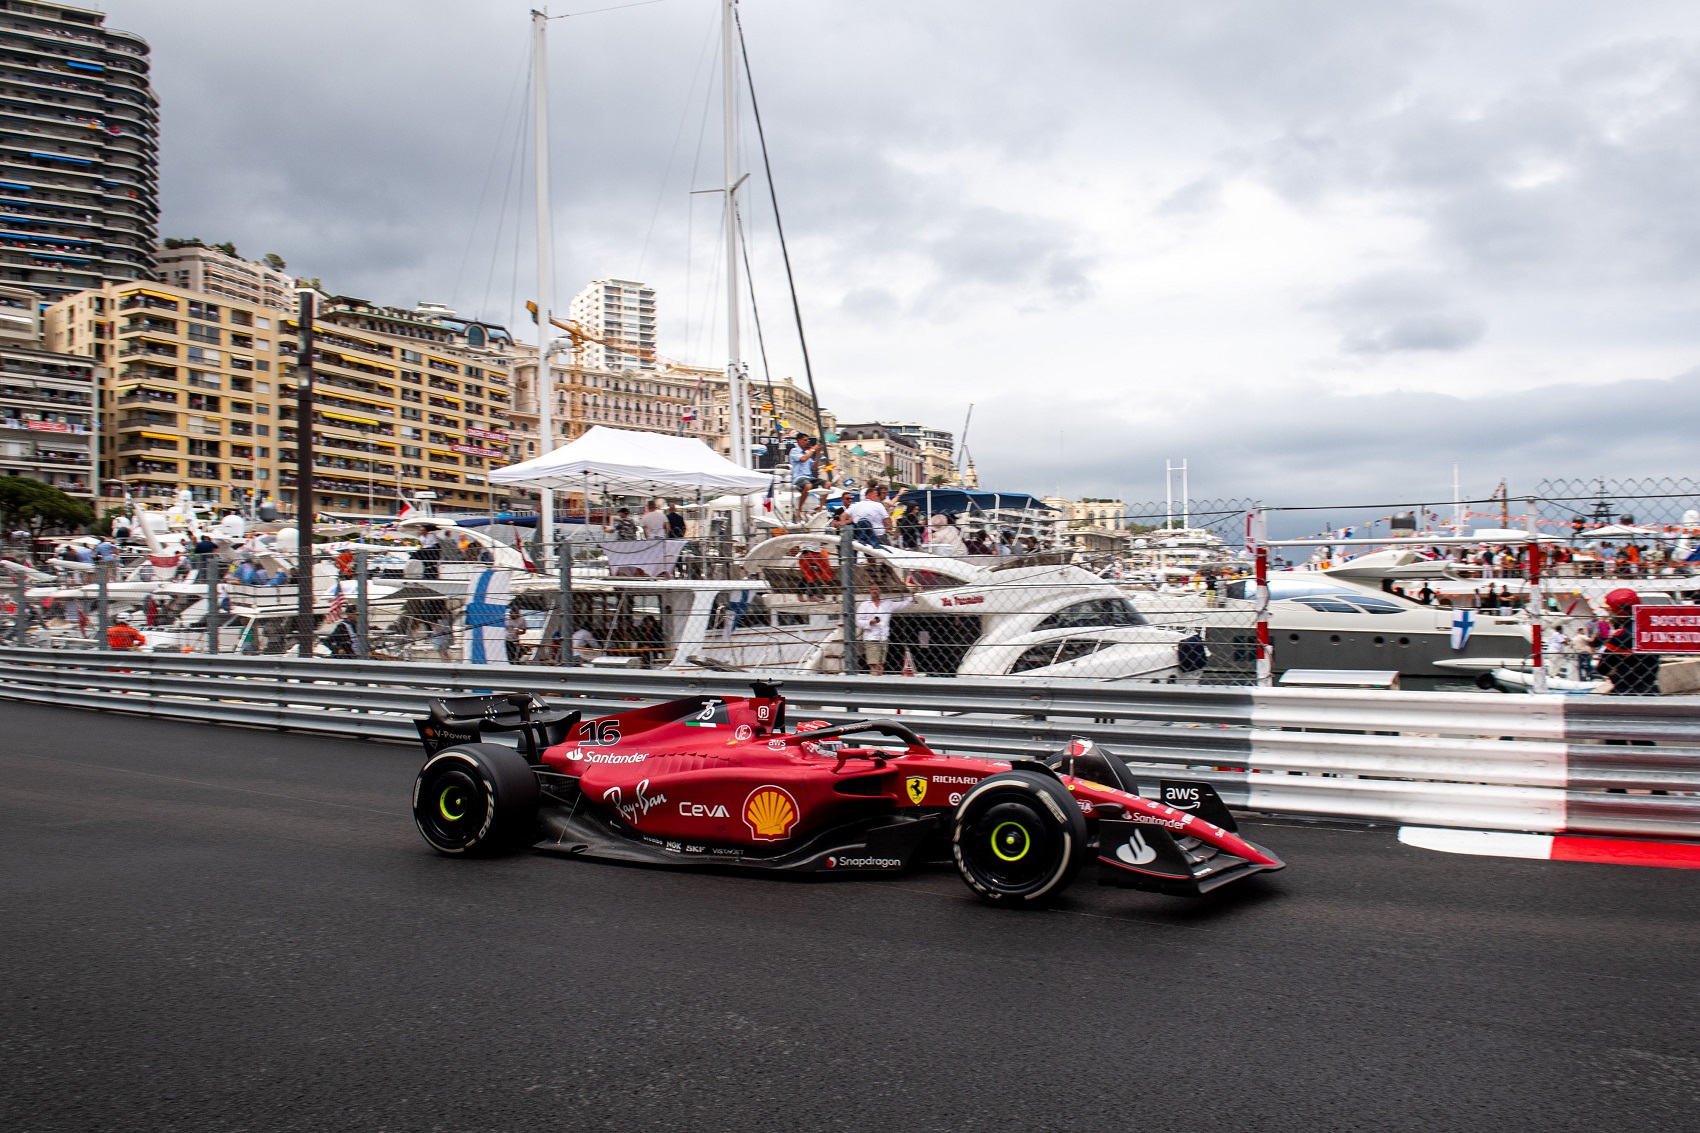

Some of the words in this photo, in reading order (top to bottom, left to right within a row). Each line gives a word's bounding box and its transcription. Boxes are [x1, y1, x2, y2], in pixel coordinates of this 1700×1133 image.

[434, 729, 472, 741] V-Power
[577, 719, 622, 747] 16
[768, 739, 786, 747] aws
[583, 750, 650, 764] Santander
[932, 775, 978, 785] RICHARD
[1165, 787, 1200, 801] aws
[1133, 812, 1185, 830] Santander
[666, 840, 682, 850] NGK
[686, 845, 706, 853] SKF
[839, 856, 901, 868] Snapdragon
